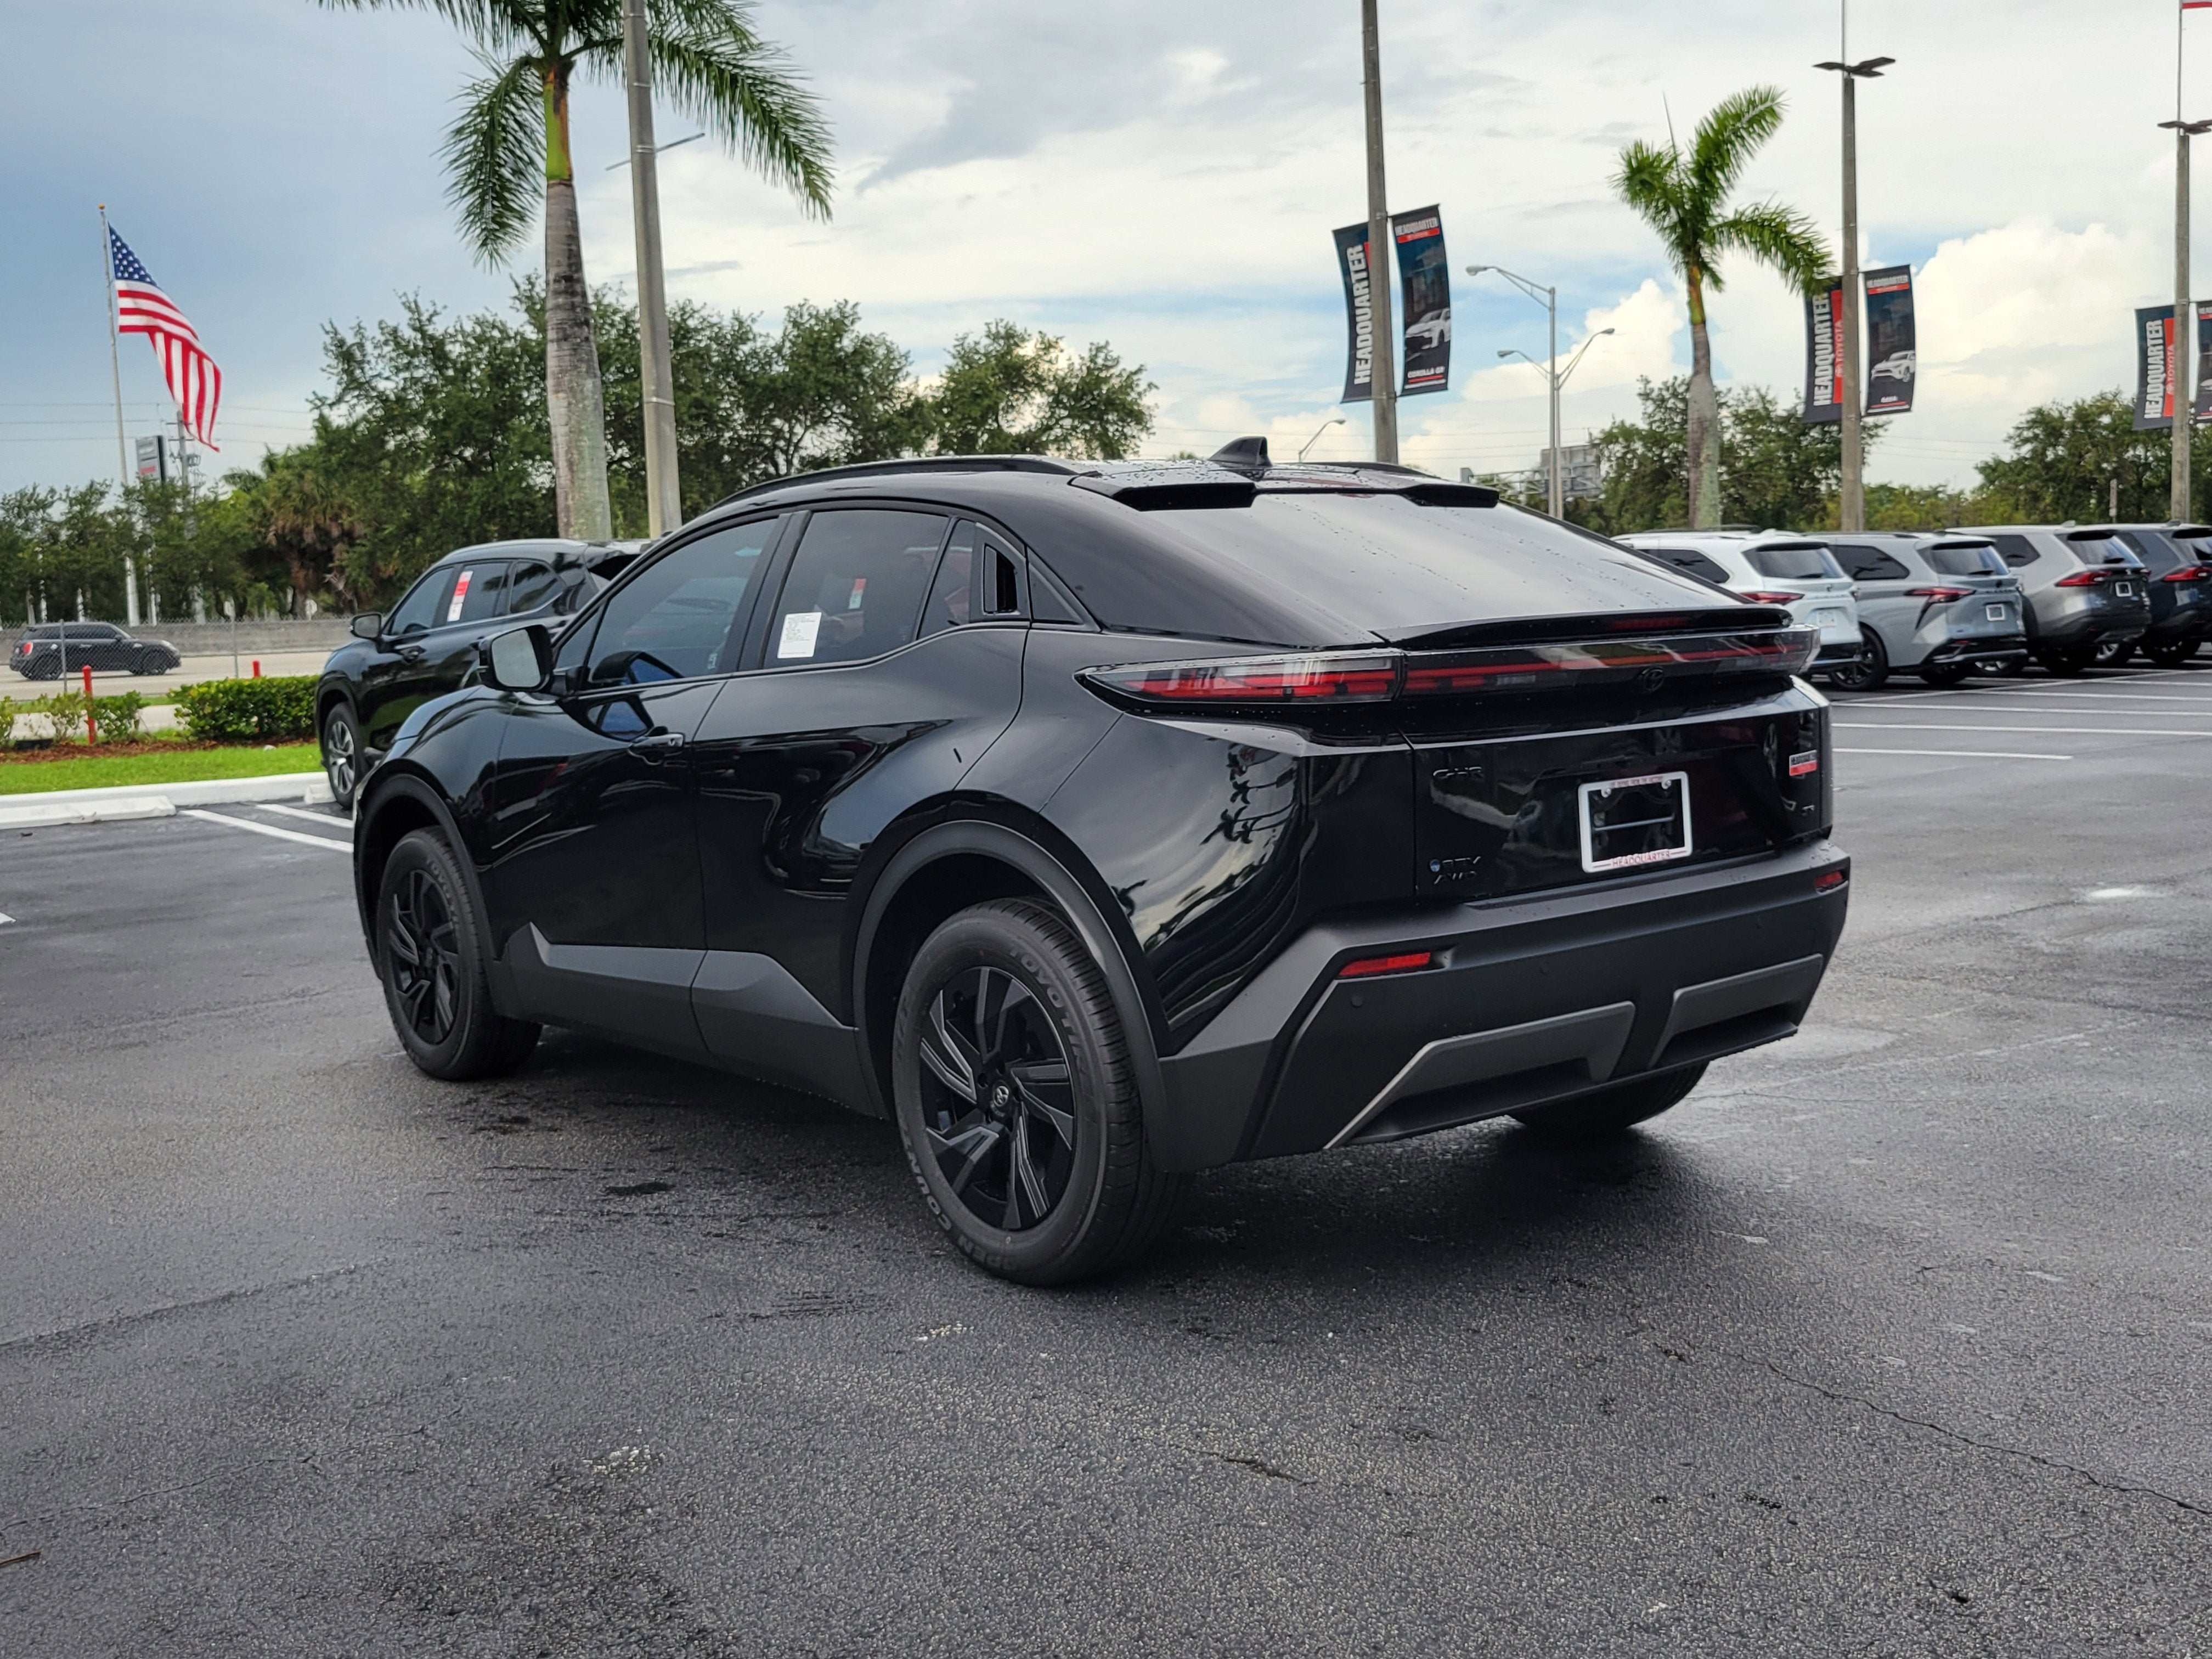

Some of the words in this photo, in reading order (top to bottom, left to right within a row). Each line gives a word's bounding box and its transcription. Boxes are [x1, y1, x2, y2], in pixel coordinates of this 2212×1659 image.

[1346, 244, 1372, 384] HEADQUARTER
[1813, 292, 1834, 406] HEADQUARTER
[2144, 319, 2166, 419] HEADQUARTER
[1612, 850, 1670, 867] HEADQUARTER
[1009, 940, 1065, 1008] TOYO
